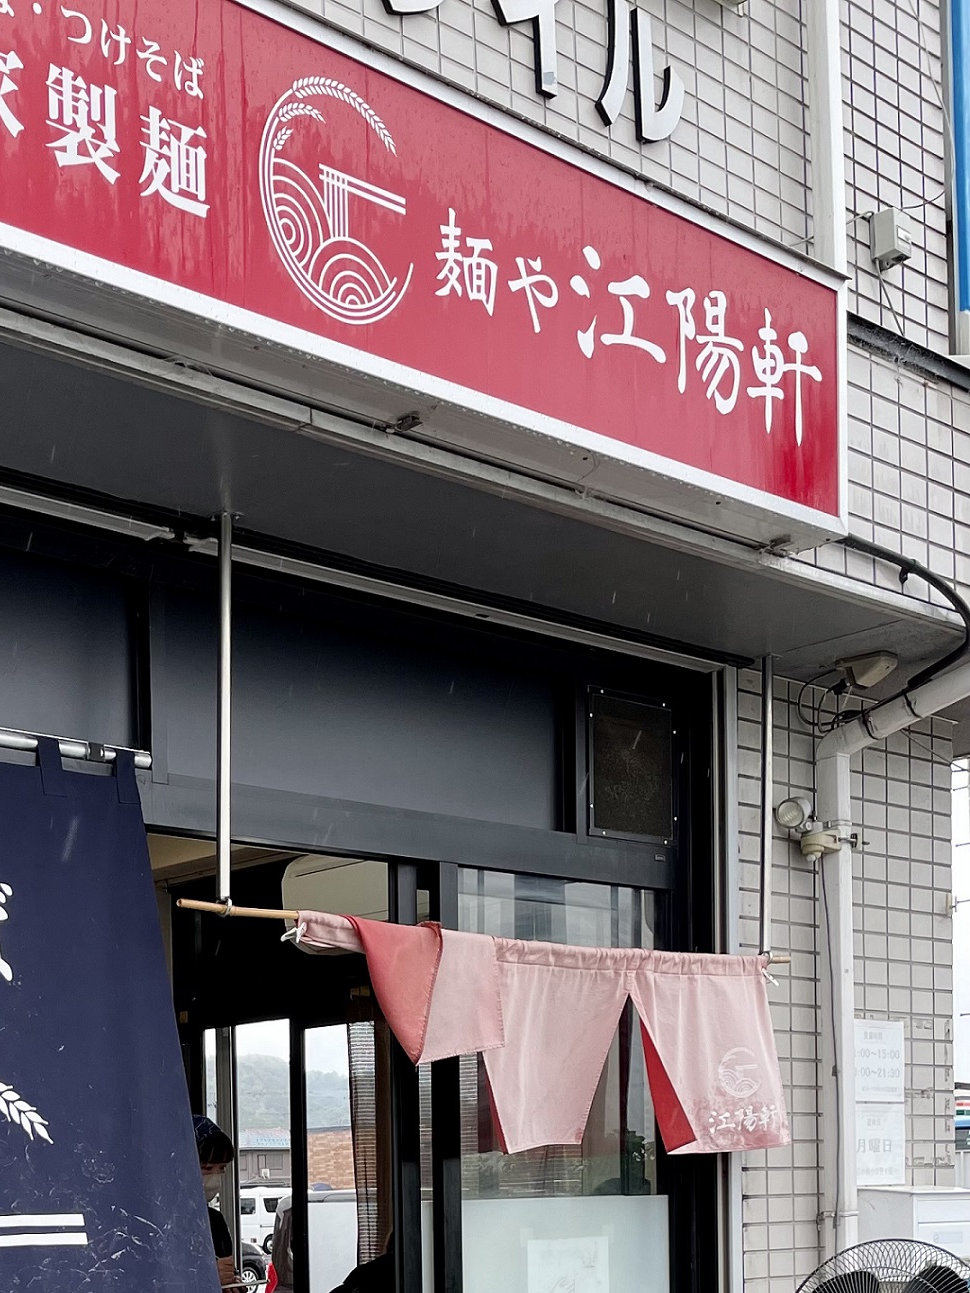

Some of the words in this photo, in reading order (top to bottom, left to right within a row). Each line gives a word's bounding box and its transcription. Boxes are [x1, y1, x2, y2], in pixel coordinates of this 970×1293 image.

[383, 0, 684, 143] イル
[434, 207, 822, 446] 麺や江陽軒
[708, 1104, 778, 1134] 江陽軒
